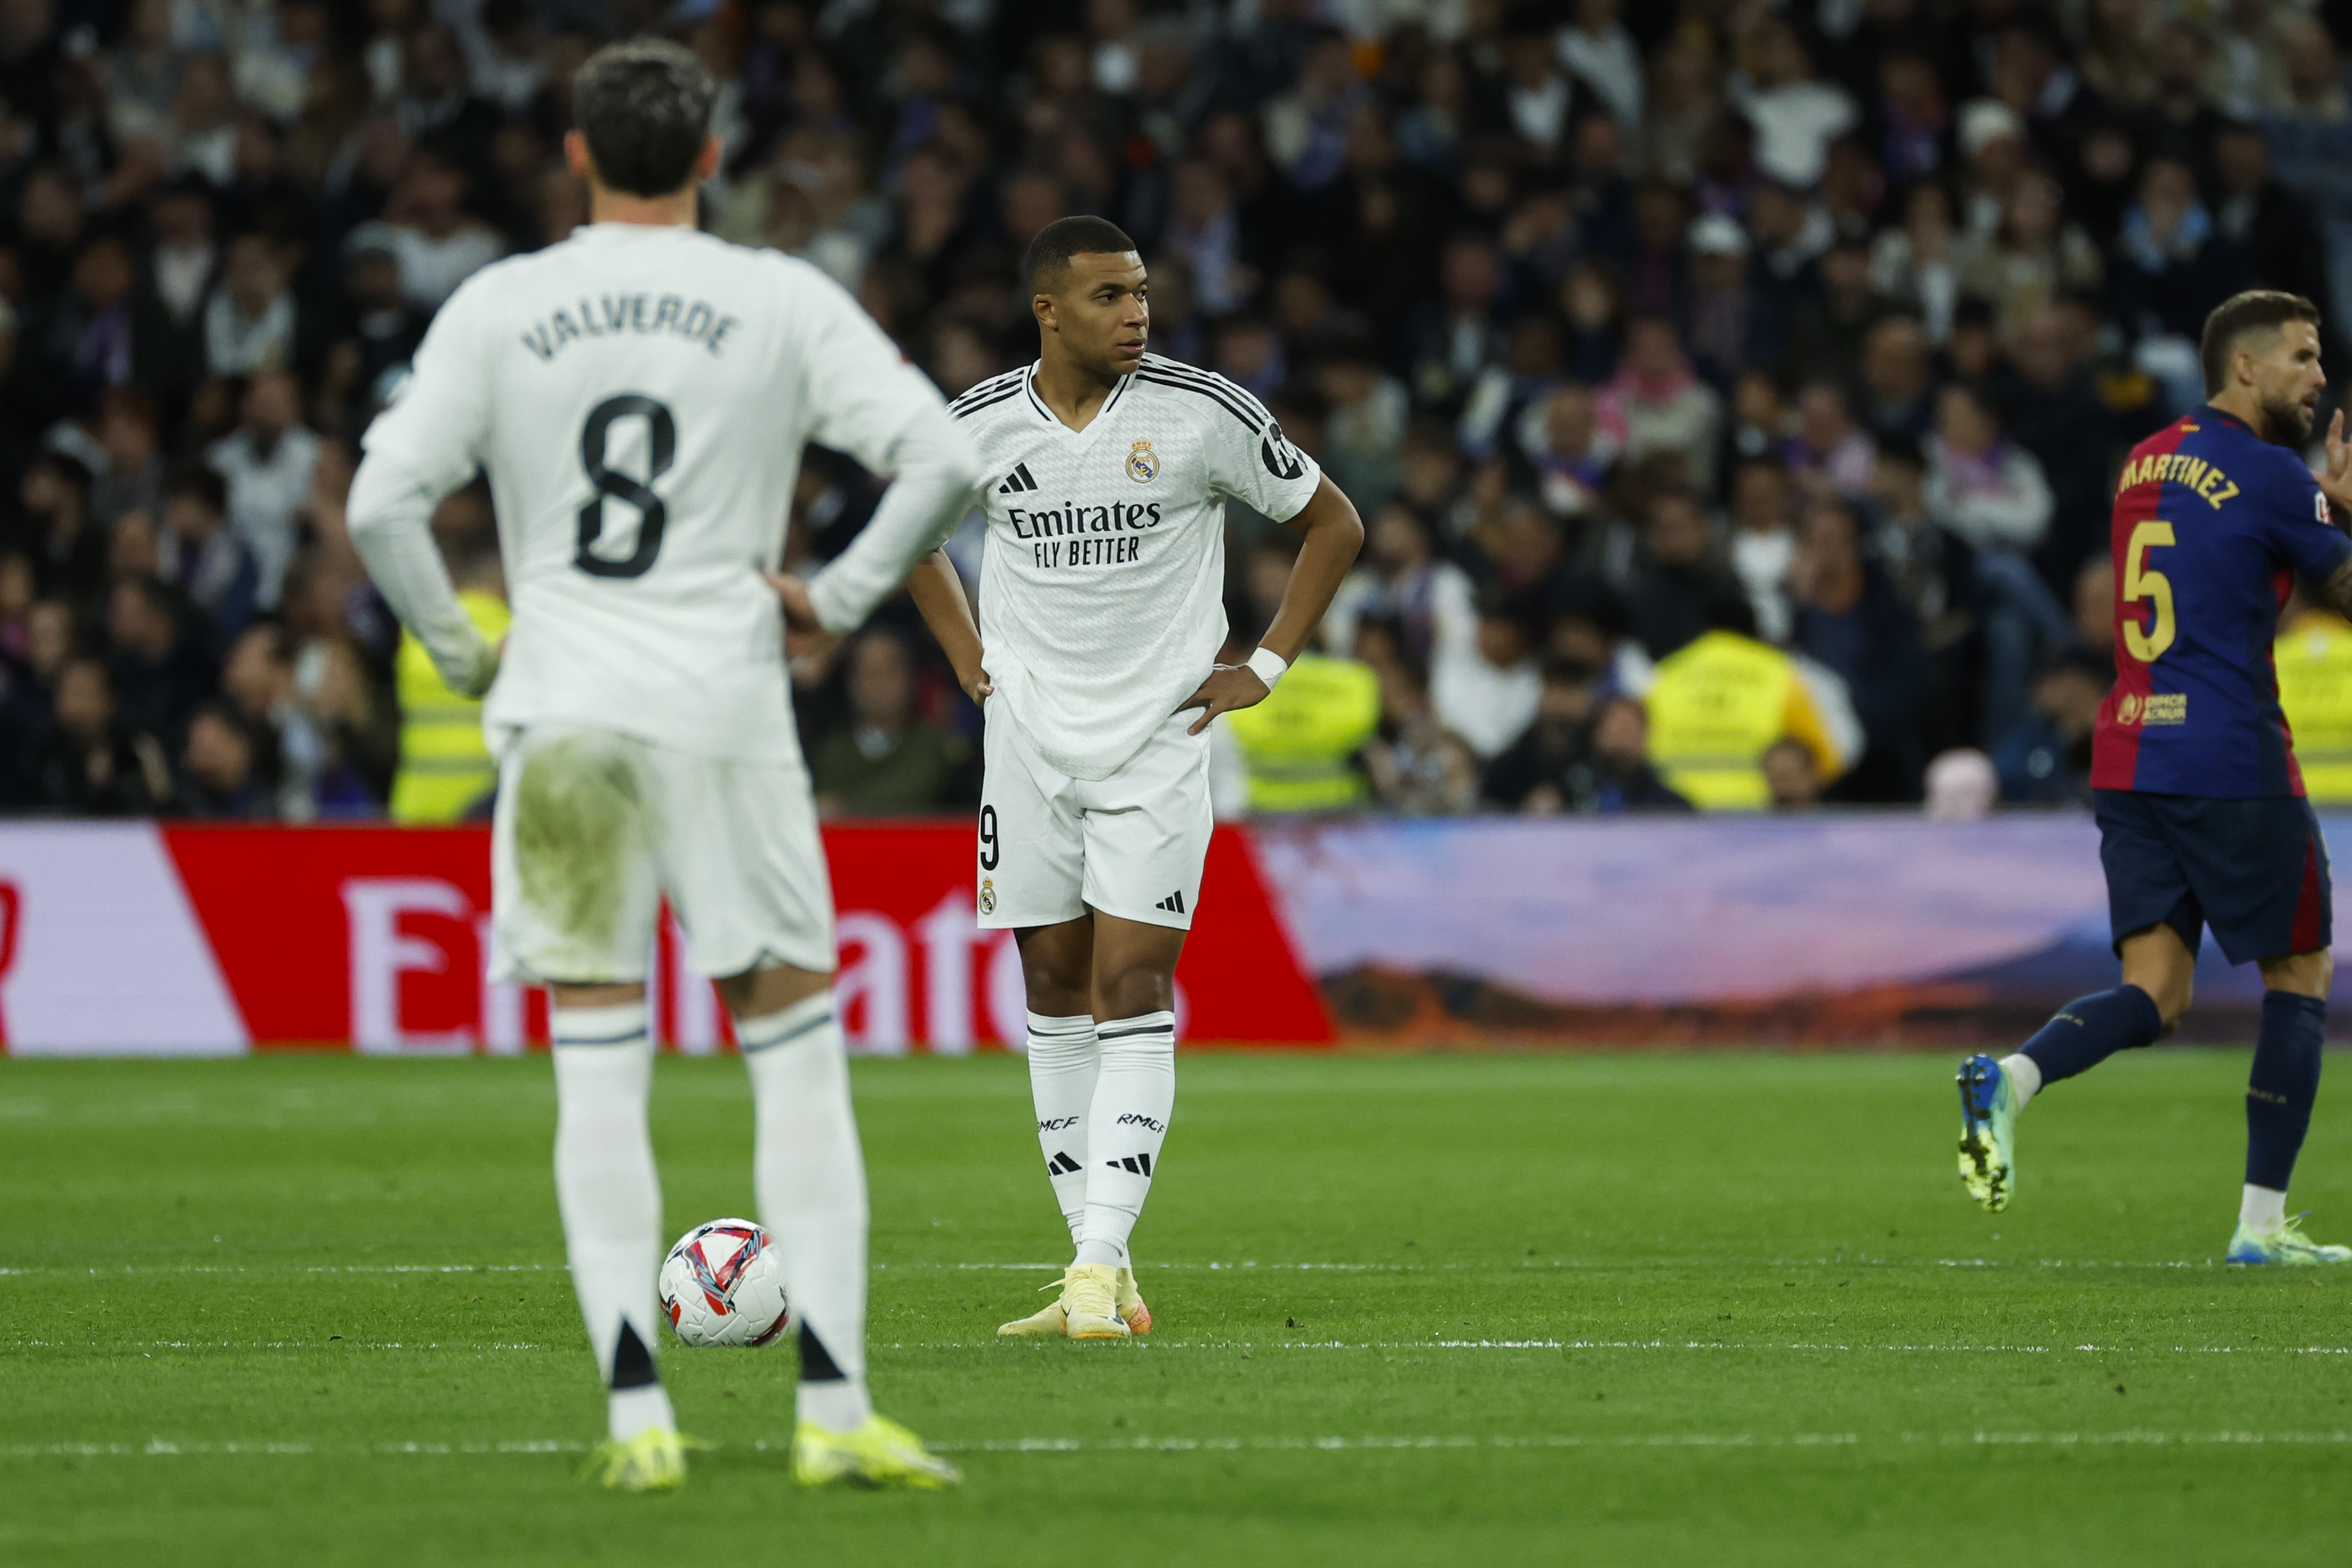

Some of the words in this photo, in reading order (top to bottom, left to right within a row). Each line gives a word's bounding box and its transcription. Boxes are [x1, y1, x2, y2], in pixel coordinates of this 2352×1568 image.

[521, 293, 740, 359] VALVERDE
[570, 392, 677, 581] 8
[2116, 454, 2240, 510] MARTINEZ
[1008, 500, 1160, 538] Emirates
[1035, 542, 1060, 568] FLY
[1069, 536, 1139, 566] BETTER
[2123, 520, 2176, 662] 5
[980, 804, 999, 871] 9
[1037, 1116, 1079, 1132] MCF
[1116, 1113, 1165, 1133] RMCF
